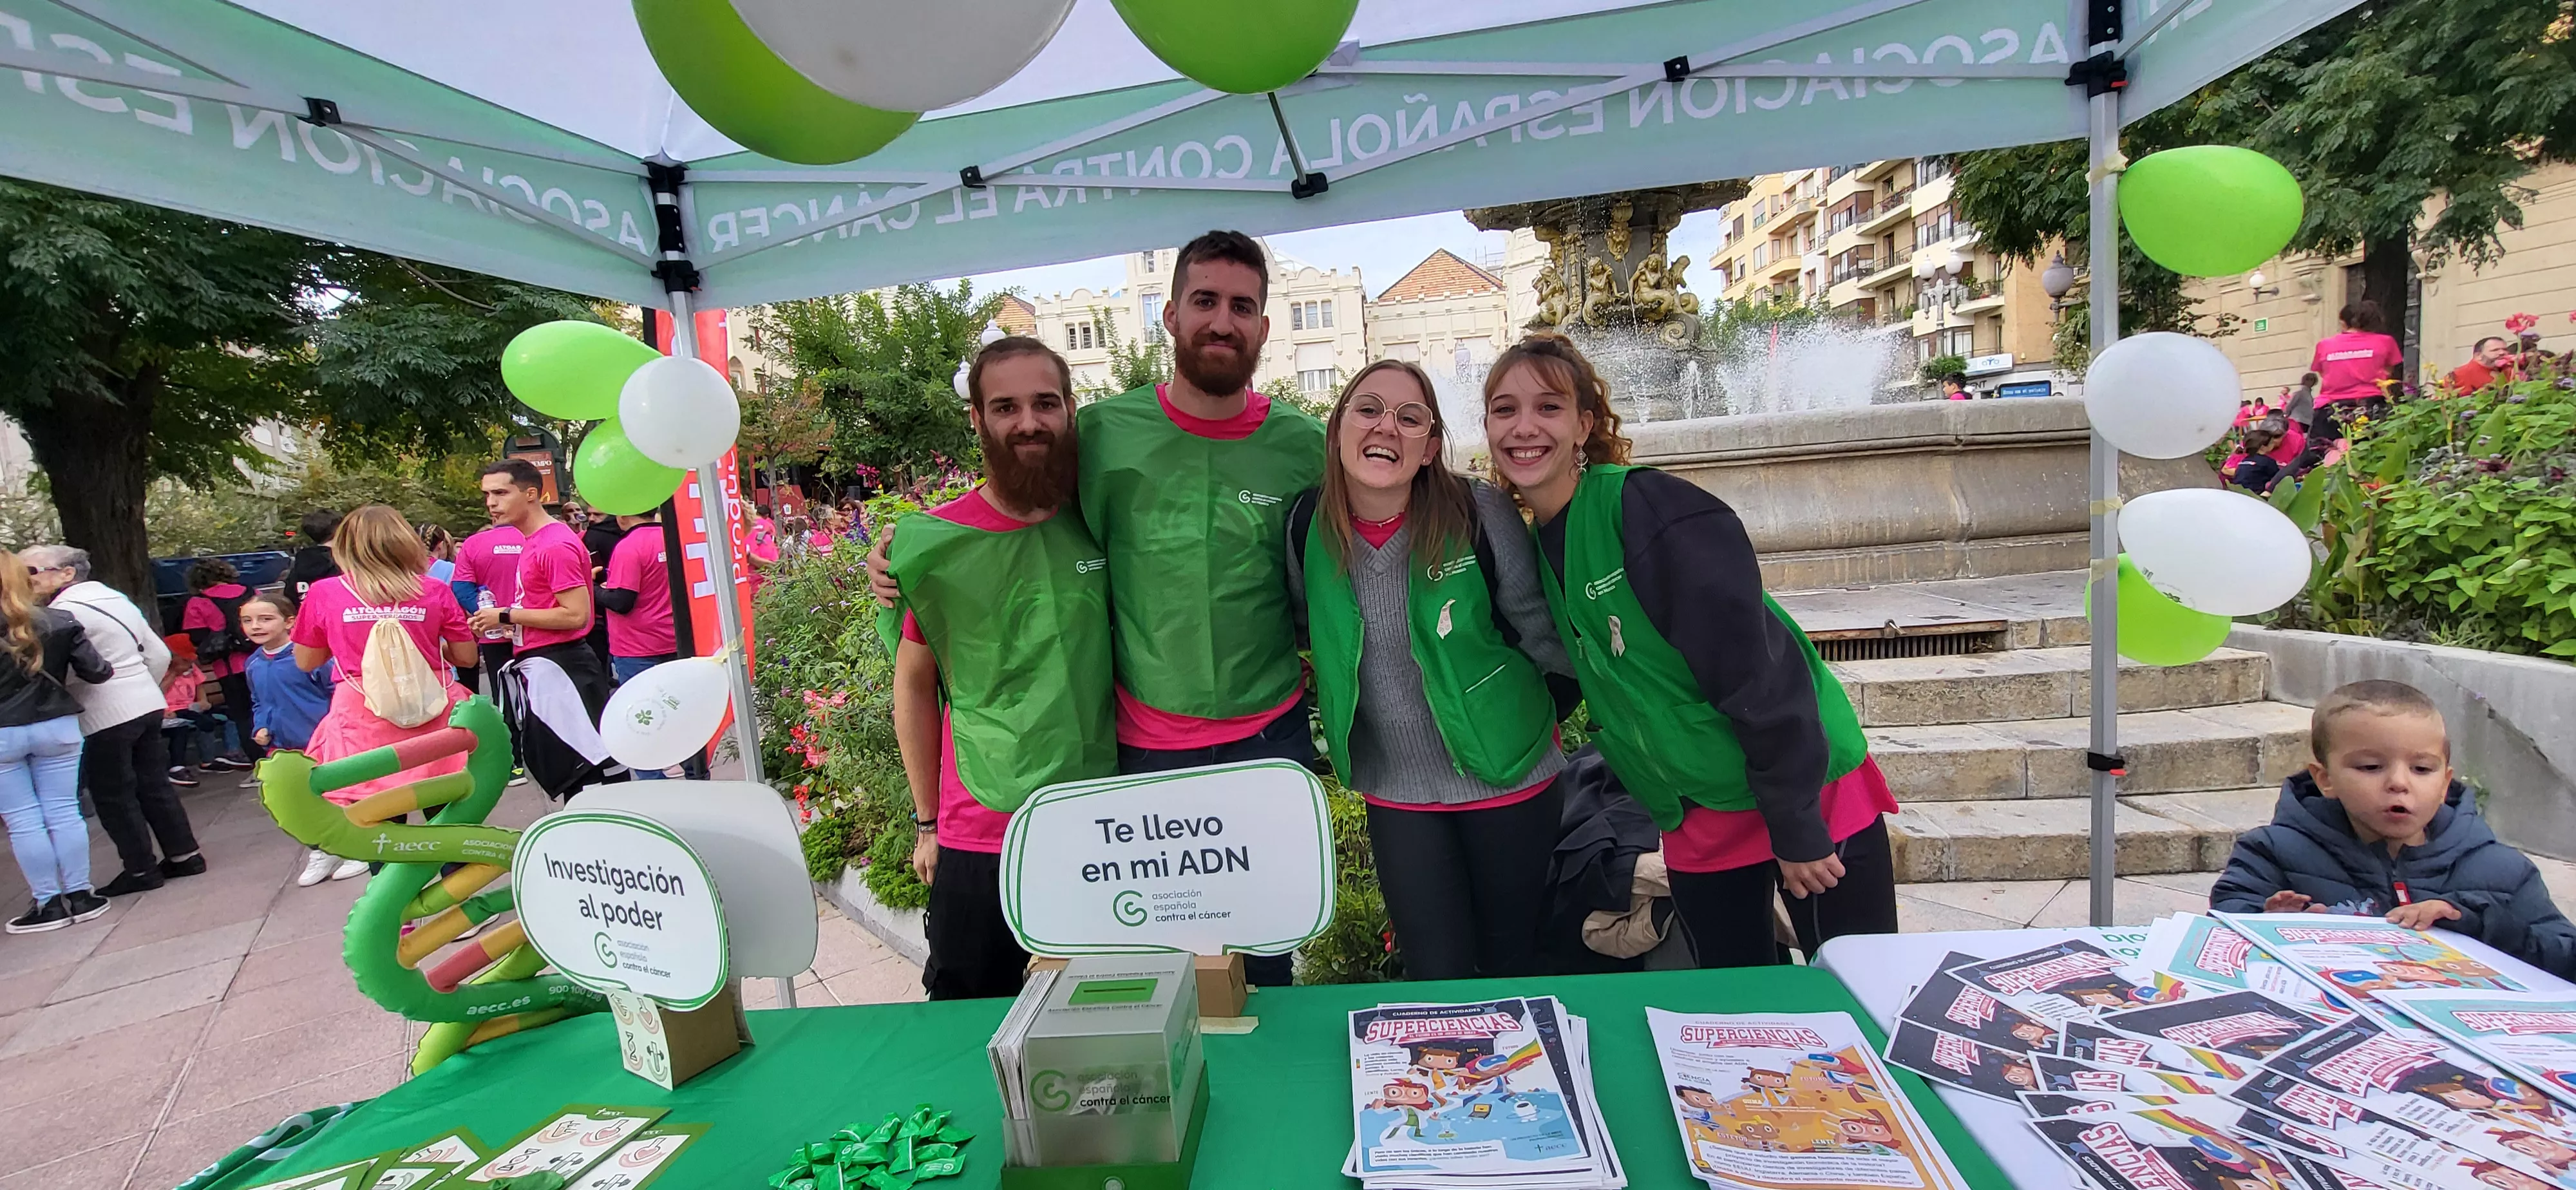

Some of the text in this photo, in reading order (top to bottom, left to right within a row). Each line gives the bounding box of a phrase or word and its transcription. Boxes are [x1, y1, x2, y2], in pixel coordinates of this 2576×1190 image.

[1095, 814, 1223, 844] Te llevo
[393, 841, 441, 852] aecc
[1082, 845, 1250, 883] en mi ADN
[544, 853, 685, 896] Investigación
[1151, 889, 1202, 900] asociación
[578, 893, 663, 931] al poder
[1153, 900, 1197, 912] española
[1155, 909, 1231, 923] contra el cáncer
[623, 961, 642, 972] contra
[643, 965, 649, 974] el
[1987, 952, 2121, 994] SUPERCIENCIAS
[549, 985, 569, 995] 900
[466, 996, 531, 1015] aecc.es
[1367, 1014, 1520, 1041] SUPERCIENCIAS
[1684, 1027, 1822, 1045] SUPERCIENCIAS
[2163, 1012, 2302, 1044] SUPERCIENCIAS
[2313, 1032, 2445, 1095] SUPERCIENCIAS
[1080, 1093, 1171, 1108] contra el cáncer
